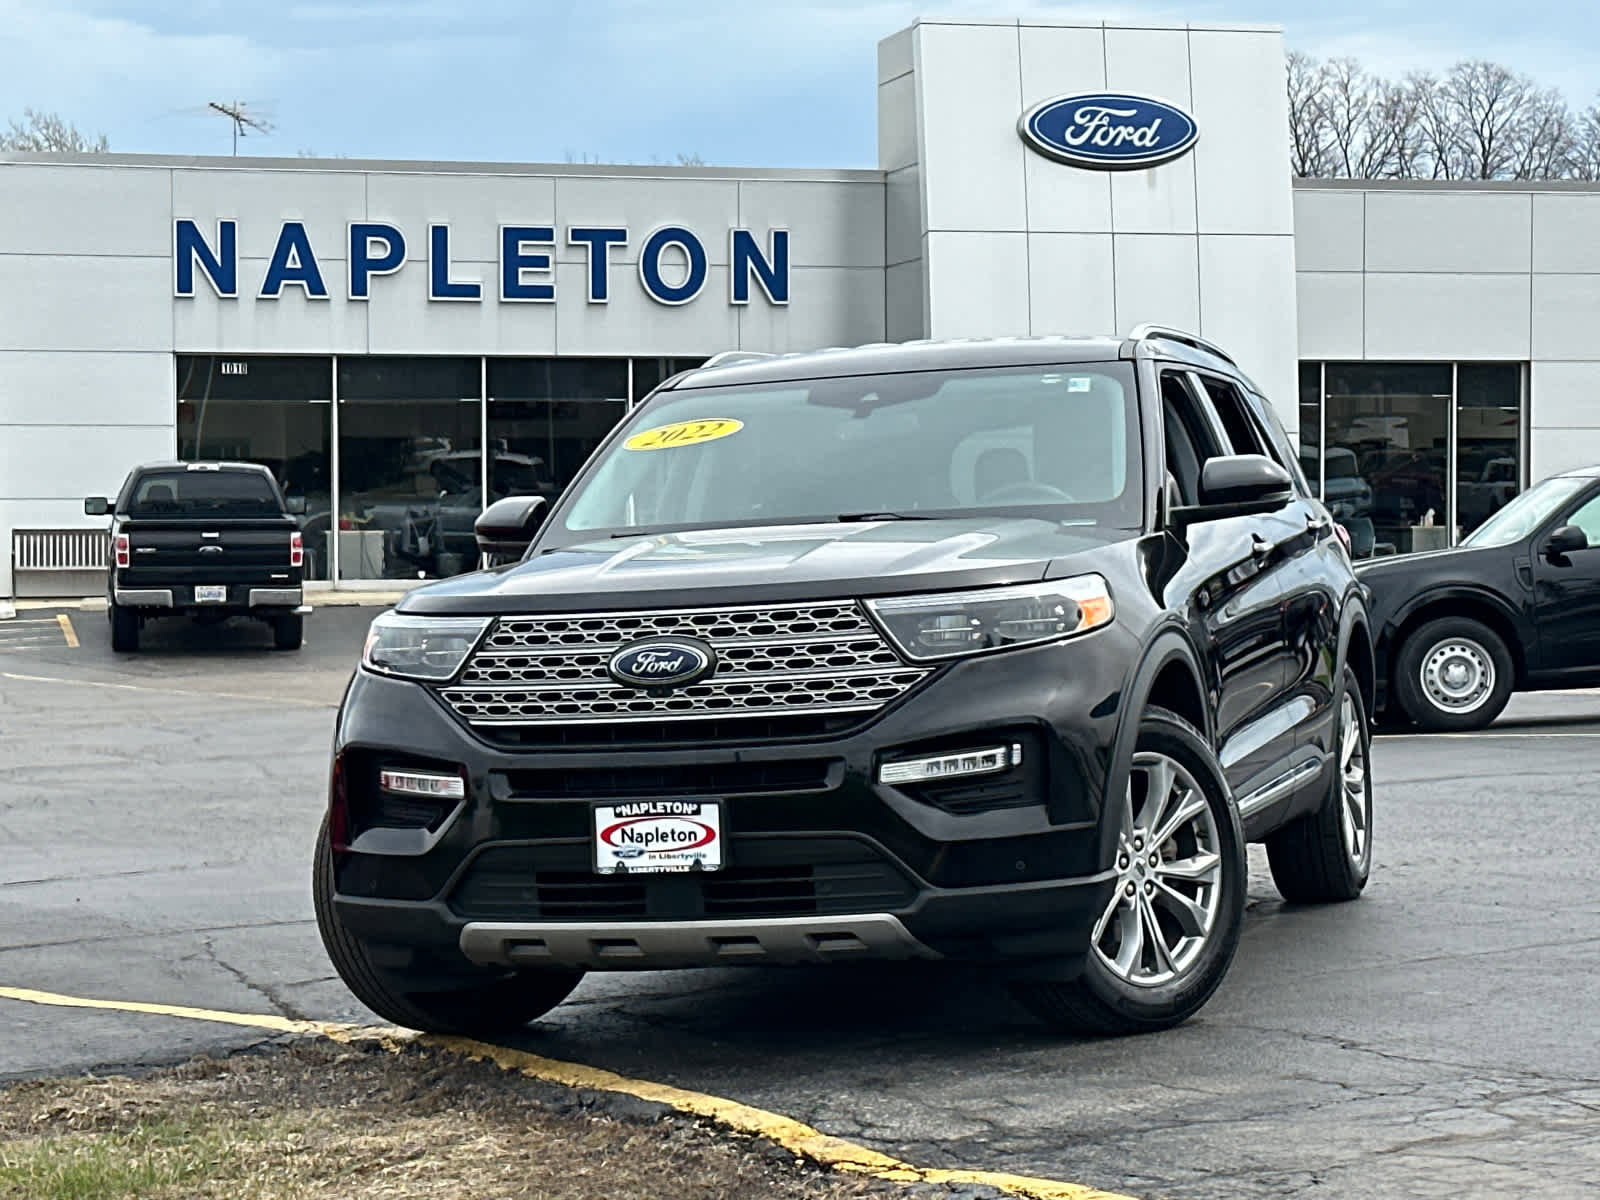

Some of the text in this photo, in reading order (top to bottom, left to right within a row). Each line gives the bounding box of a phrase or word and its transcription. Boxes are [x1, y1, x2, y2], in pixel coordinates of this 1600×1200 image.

[1064, 106, 1162, 147] Ford
[173, 217, 790, 305] NAPLETON
[641, 423, 724, 446] 2022
[632, 652, 684, 674] Ford
[621, 802, 692, 816] NAPLETON
[621, 827, 697, 847] Napleton
